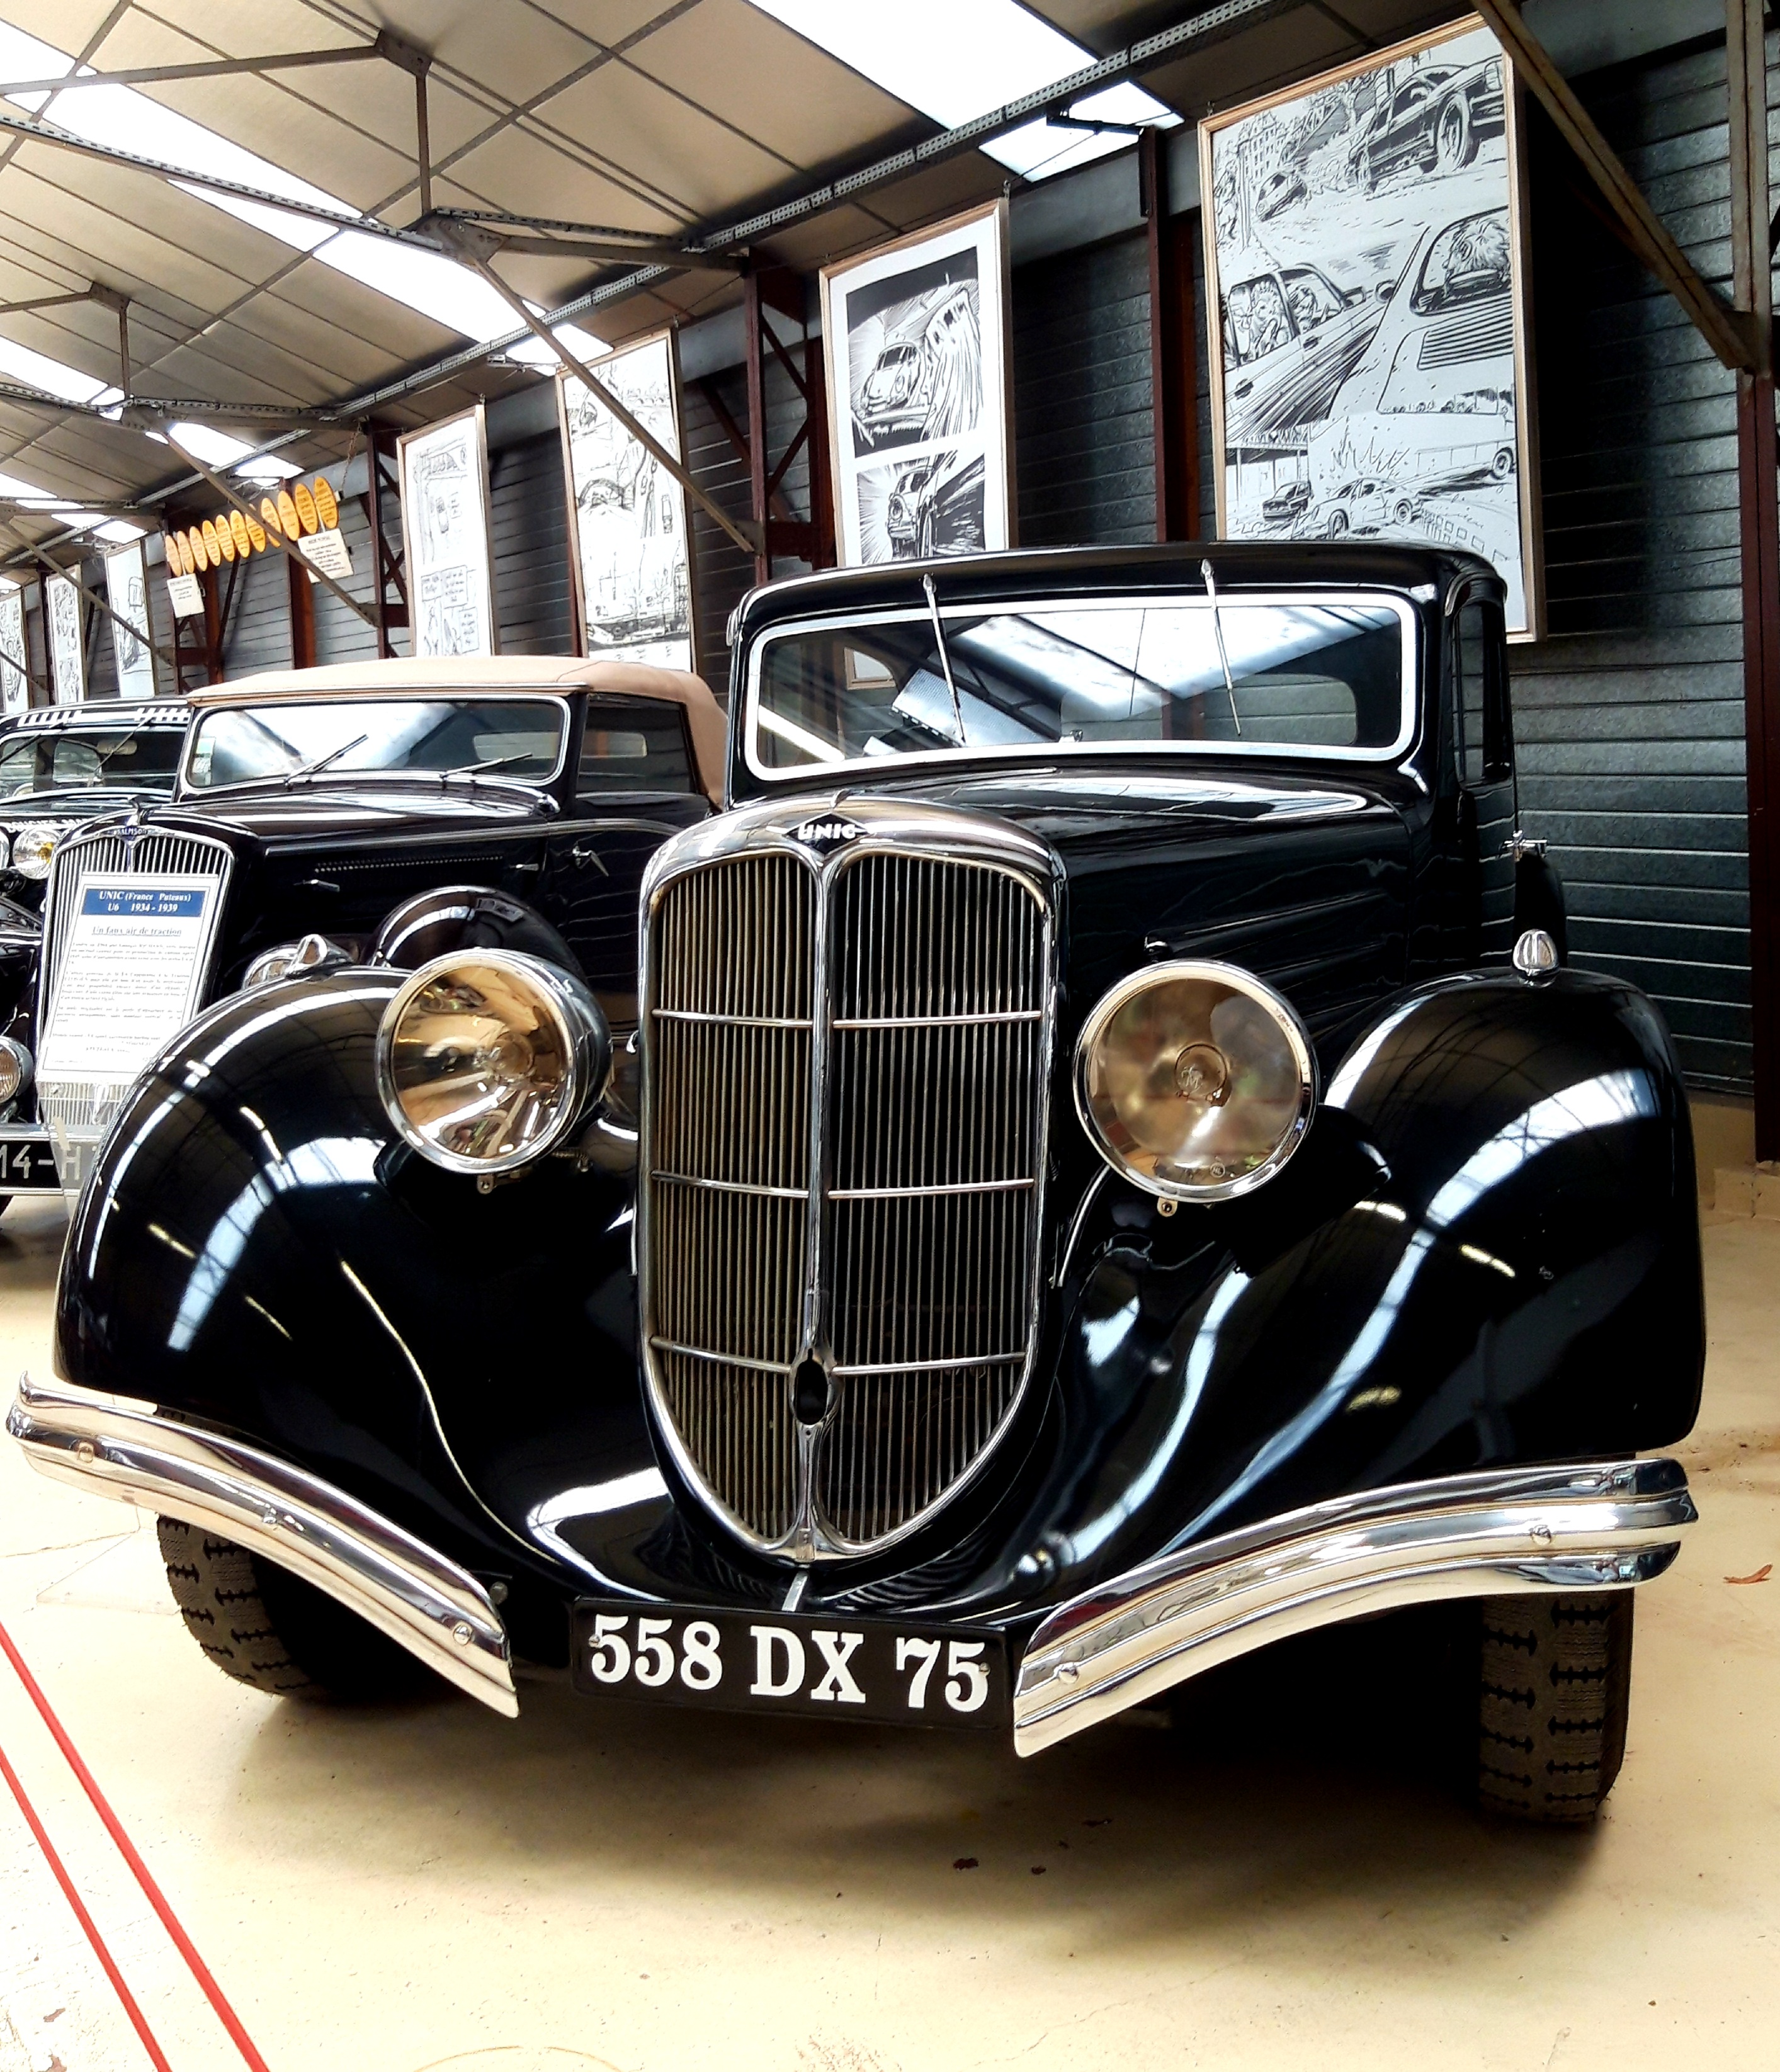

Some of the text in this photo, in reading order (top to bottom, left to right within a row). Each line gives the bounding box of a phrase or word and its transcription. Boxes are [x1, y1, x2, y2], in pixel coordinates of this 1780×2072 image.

[798, 824, 856, 840] UNIC
[99, 890, 124, 900] UNIC
[125, 892, 154, 901] (France
[108, 903, 120, 912] U6
[131, 903, 150, 912] 1934
[158, 903, 178, 913] 1939
[93, 926, 104, 934] Un
[126, 926, 137, 936] air
[139, 927, 149, 935] de
[151, 927, 182, 936] traction
[591, 1614, 989, 1713] 558 DX 75
